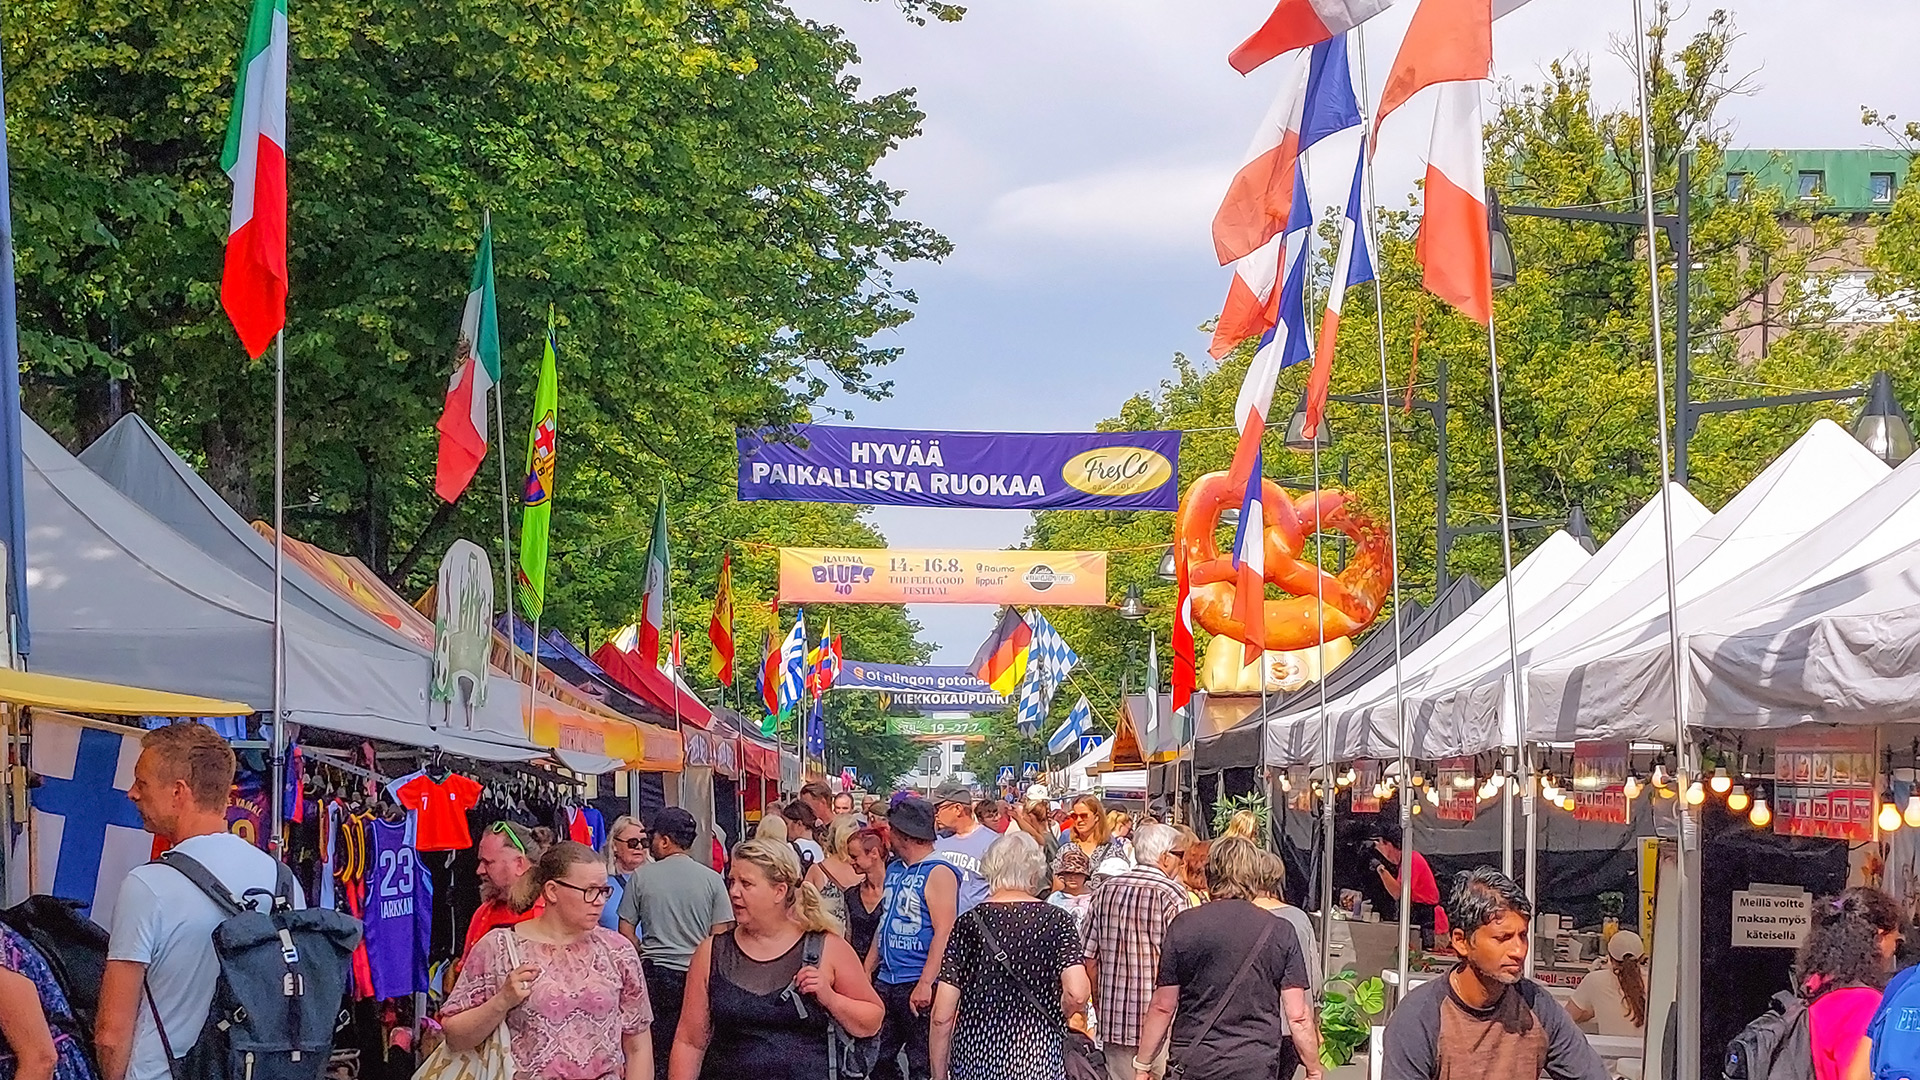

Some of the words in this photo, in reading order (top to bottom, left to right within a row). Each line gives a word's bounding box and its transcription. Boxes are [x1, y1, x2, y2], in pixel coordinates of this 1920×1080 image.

[851, 439, 944, 467] HYVÄÄ
[1084, 452, 1149, 483] FresCo
[752, 462, 923, 494] PAIKALLISTA
[930, 473, 1046, 496] RUOKAA
[823, 555, 863, 564] RAUMA
[811, 564, 875, 584] BLUES
[888, 575, 909, 585] THE
[910, 576, 934, 585] FEEL
[935, 576, 965, 585] GOOD
[834, 584, 853, 595] 40
[903, 586, 948, 595] FESTIVAL
[380, 847, 414, 897] 23
[1739, 898, 1771, 908] Meillä
[1773, 898, 1805, 908] voitte
[1737, 914, 1776, 923] maksaa
[1778, 914, 1807, 926] myös
[1746, 929, 1796, 940] käteisellä
